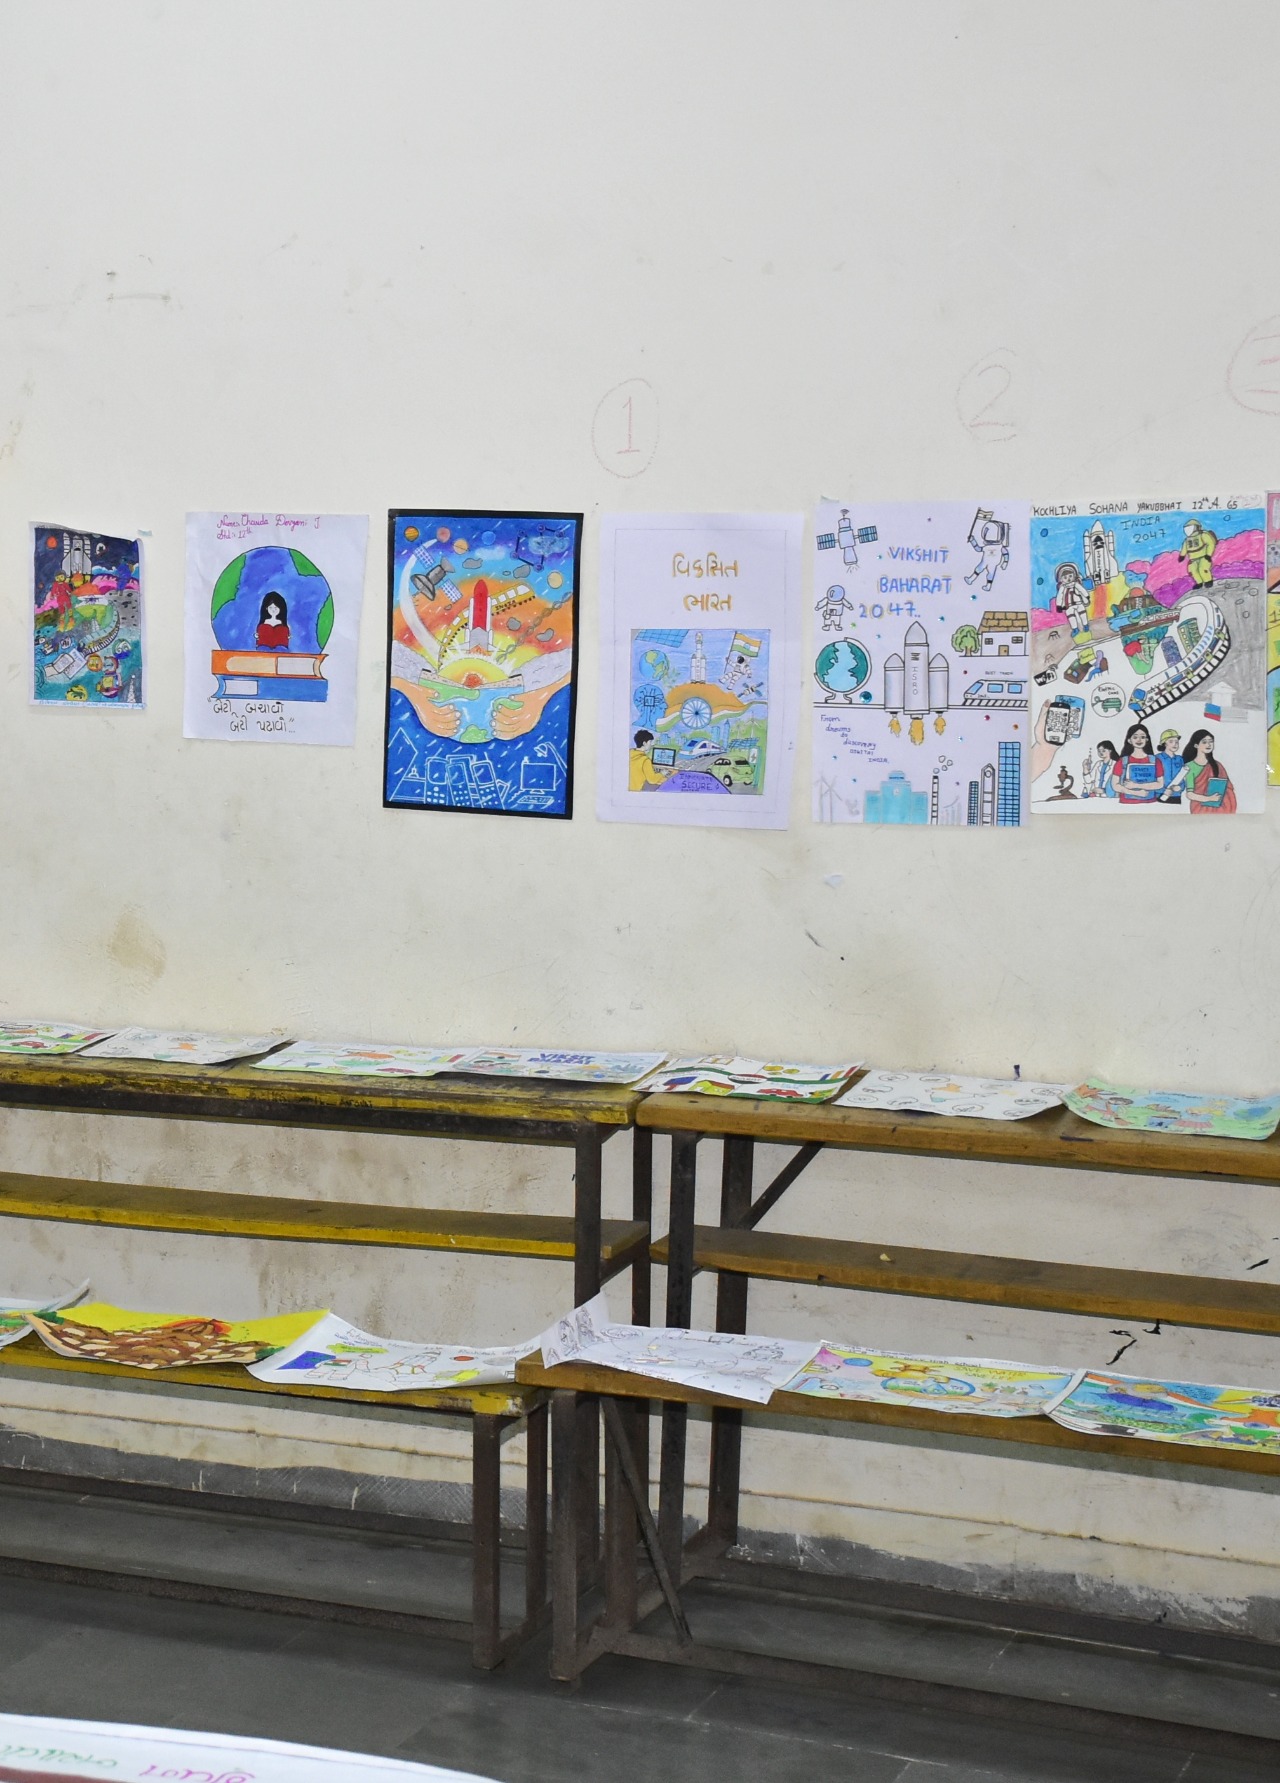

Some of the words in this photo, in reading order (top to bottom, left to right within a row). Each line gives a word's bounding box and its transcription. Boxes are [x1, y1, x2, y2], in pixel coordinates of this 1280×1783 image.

[1089, 501, 1128, 515] SOHANA
[1121, 515, 1160, 530] INDIA
[1132, 529, 1167, 544] 2047
[887, 546, 949, 563] VIKSHIT
[878, 575, 952, 595] BAHARAT
[682, 593, 732, 612] ભારત
[911, 666, 919, 696] ISRO
[681, 780, 713, 791] SECURE
